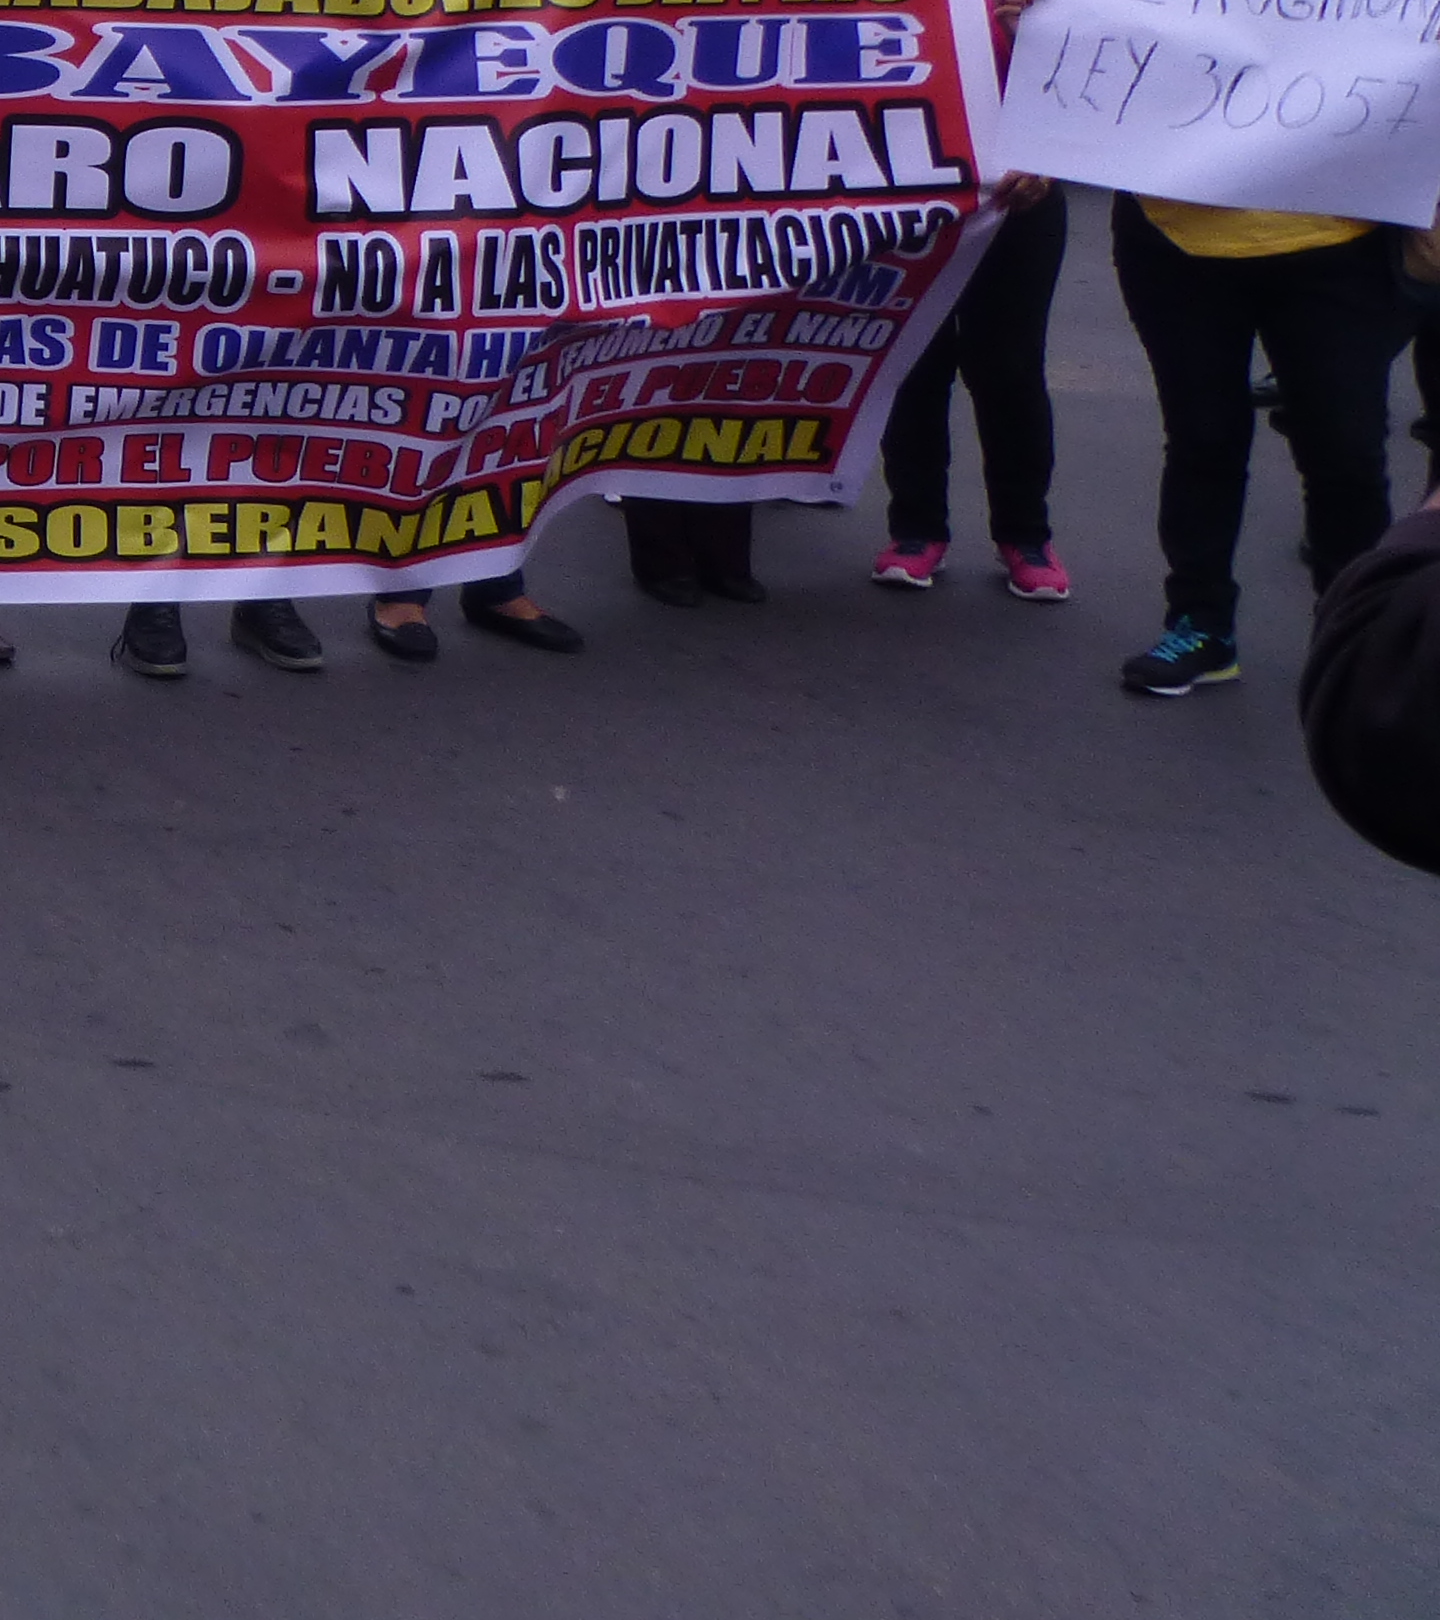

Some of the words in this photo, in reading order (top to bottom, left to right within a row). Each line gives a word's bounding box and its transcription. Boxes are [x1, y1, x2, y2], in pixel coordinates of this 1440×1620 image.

[1043, 27, 1159, 125] LEY
[1169, 53, 1423, 138] 30057
[314, 108, 962, 213] NACIONAL
[319, 238, 398, 314] NO
[420, 237, 454, 313] A
[479, 233, 565, 313] LAS
[68, 381, 407, 426] EMERGENCIAS
[509, 361, 549, 406] EL
[730, 312, 773, 346] EL
[784, 311, 896, 352] NIÑO
[95, 322, 176, 372] DE
[200, 325, 454, 377] OLLANTA
[122, 433, 192, 484] EL
[205, 433, 462, 498] PUEBLO
[577, 371, 632, 419] EL
[634, 359, 854, 407] PUEBLO
